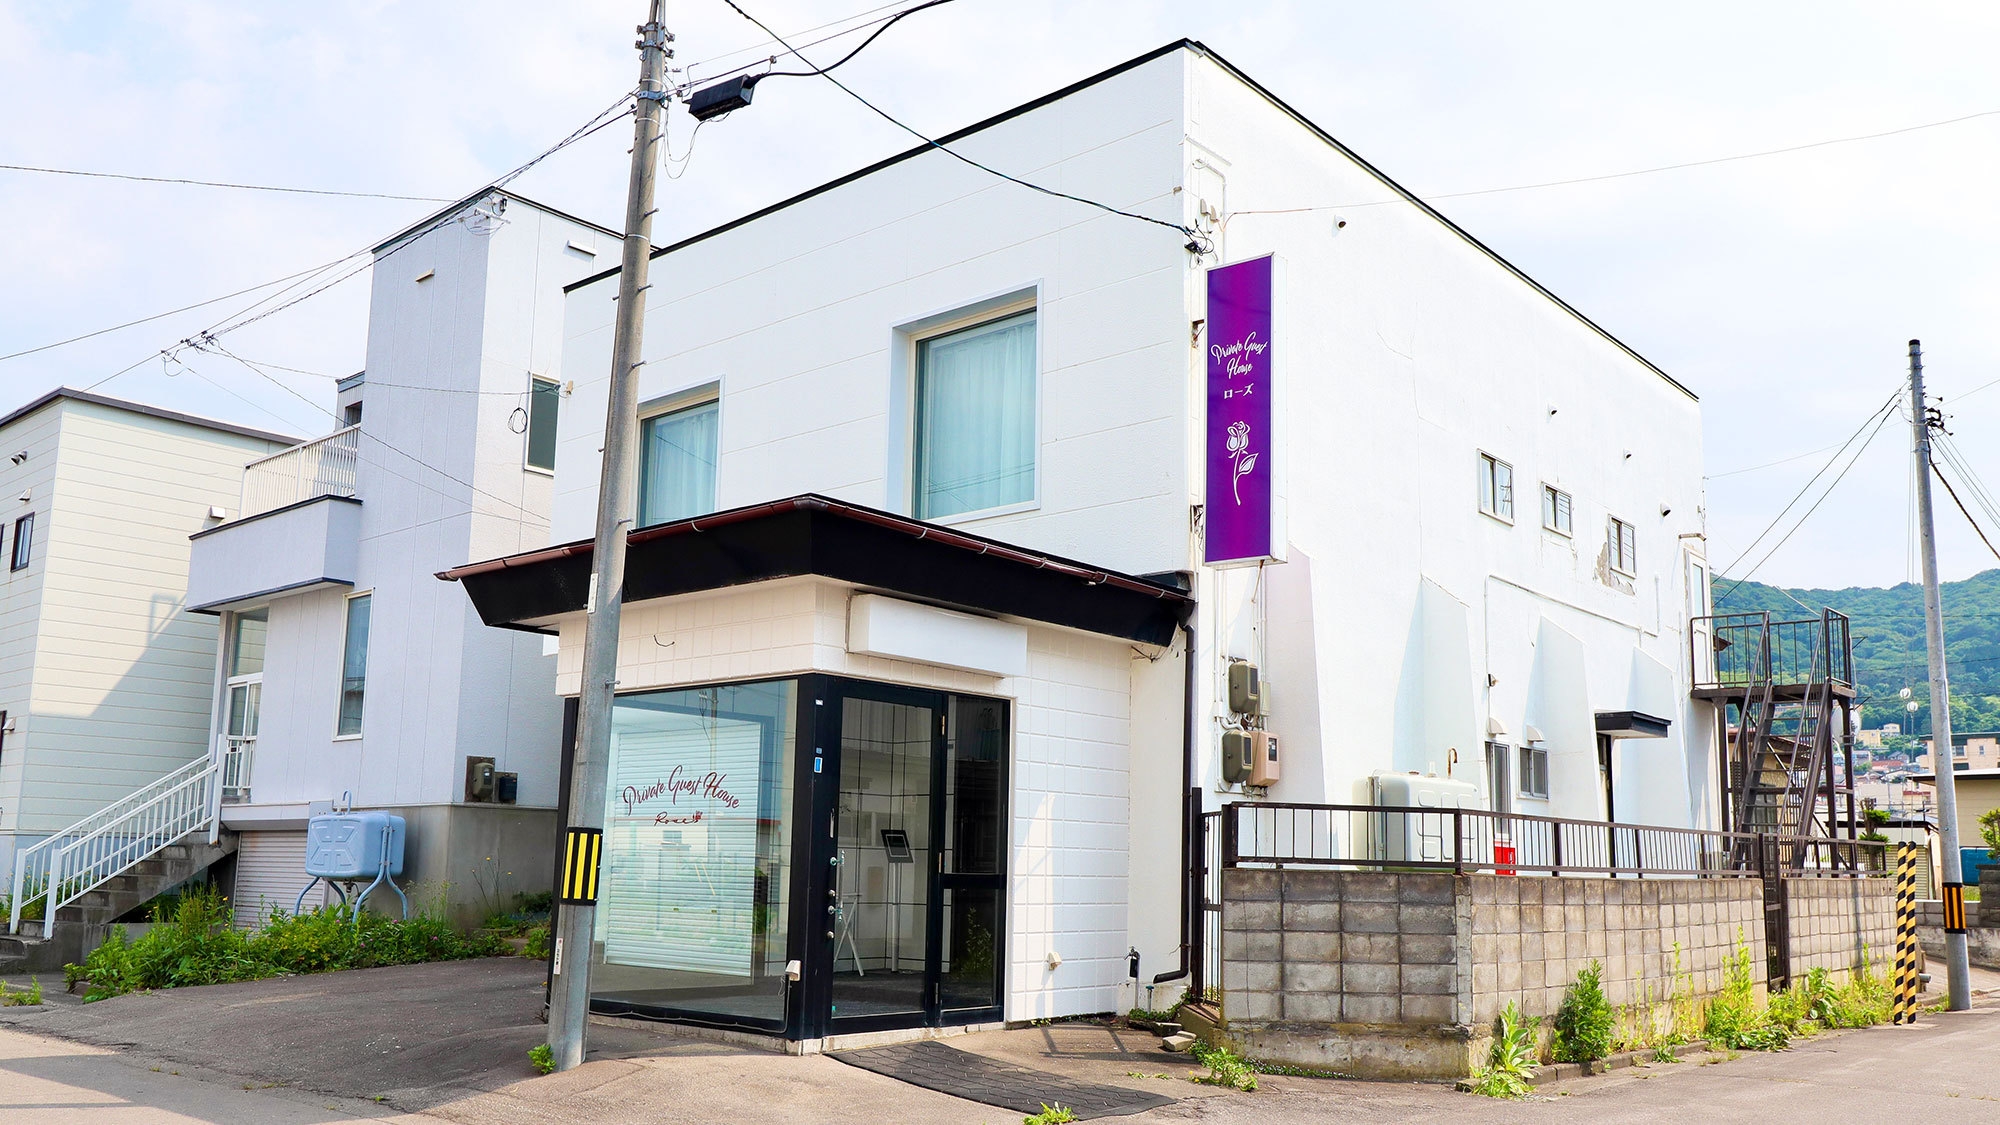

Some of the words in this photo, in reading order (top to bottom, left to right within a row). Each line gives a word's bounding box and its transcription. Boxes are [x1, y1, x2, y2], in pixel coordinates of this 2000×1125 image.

[1210, 339, 1243, 365] Private
[1244, 331, 1268, 361] Guest
[1227, 355, 1253, 379] House
[1224, 383, 1254, 399] ローズ
[622, 778, 665, 816] Private
[668, 764, 702, 805] Guest
[703, 771, 740, 808] House
